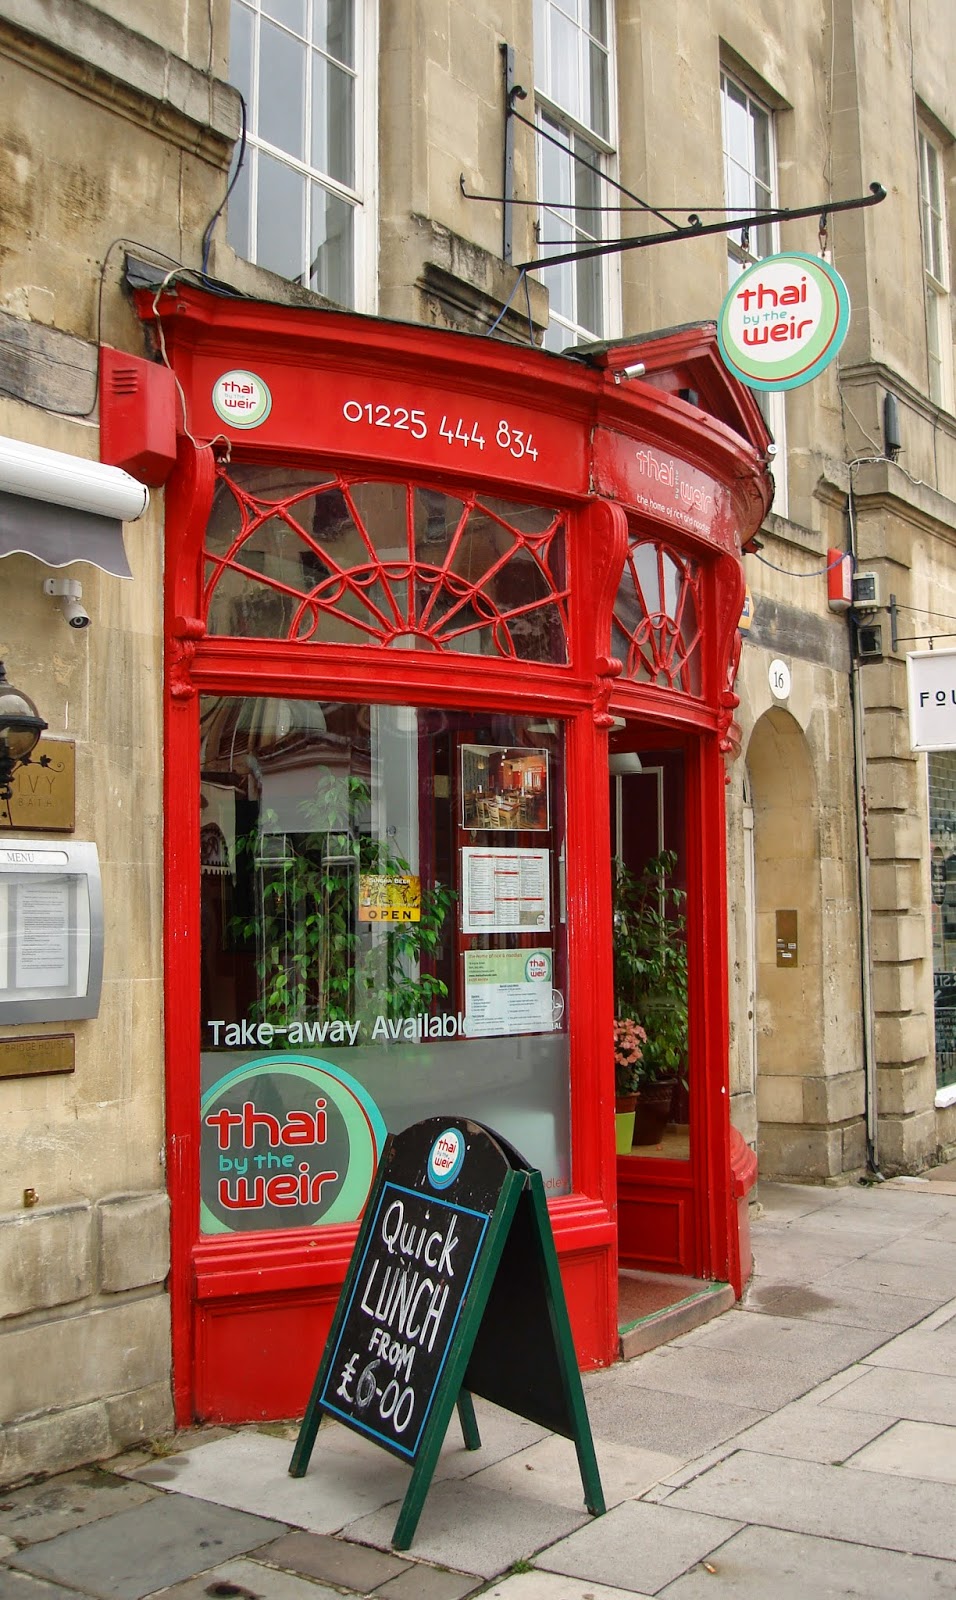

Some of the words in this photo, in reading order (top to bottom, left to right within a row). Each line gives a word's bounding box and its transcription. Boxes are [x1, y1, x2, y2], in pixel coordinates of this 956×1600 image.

[737, 276, 807, 312] thai
[743, 314, 760, 326] by
[763, 310, 788, 321] the
[743, 316, 813, 346] weir
[222, 381, 254, 394] thai
[224, 398, 257, 409] weir
[343, 400, 428, 439] 01225
[439, 415, 486, 450] 444
[495, 420, 539, 462] 834
[636, 450, 674, 488] thai
[636, 493, 649, 506] the
[649, 498, 666, 513] home
[666, 506, 673, 518] of
[680, 481, 712, 514] weir
[773, 671, 784, 689] 16
[18, 774, 56, 794] IVY
[6, 852, 35, 863] MENU
[368, 910, 412, 920] OPEN
[529, 959, 546, 968] thai
[530, 970, 547, 978] weir
[207, 1018, 361, 1046] Take-away
[205, 1098, 327, 1150] thai
[438, 1138, 458, 1154] thai
[219, 1154, 248, 1175] by
[253, 1152, 295, 1169] the
[434, 1157, 453, 1169] weir
[217, 1161, 338, 1211] weir
[381, 1200, 459, 1277] Quick
[360, 1258, 450, 1354] LUNCH
[368, 1327, 417, 1383] FROM
